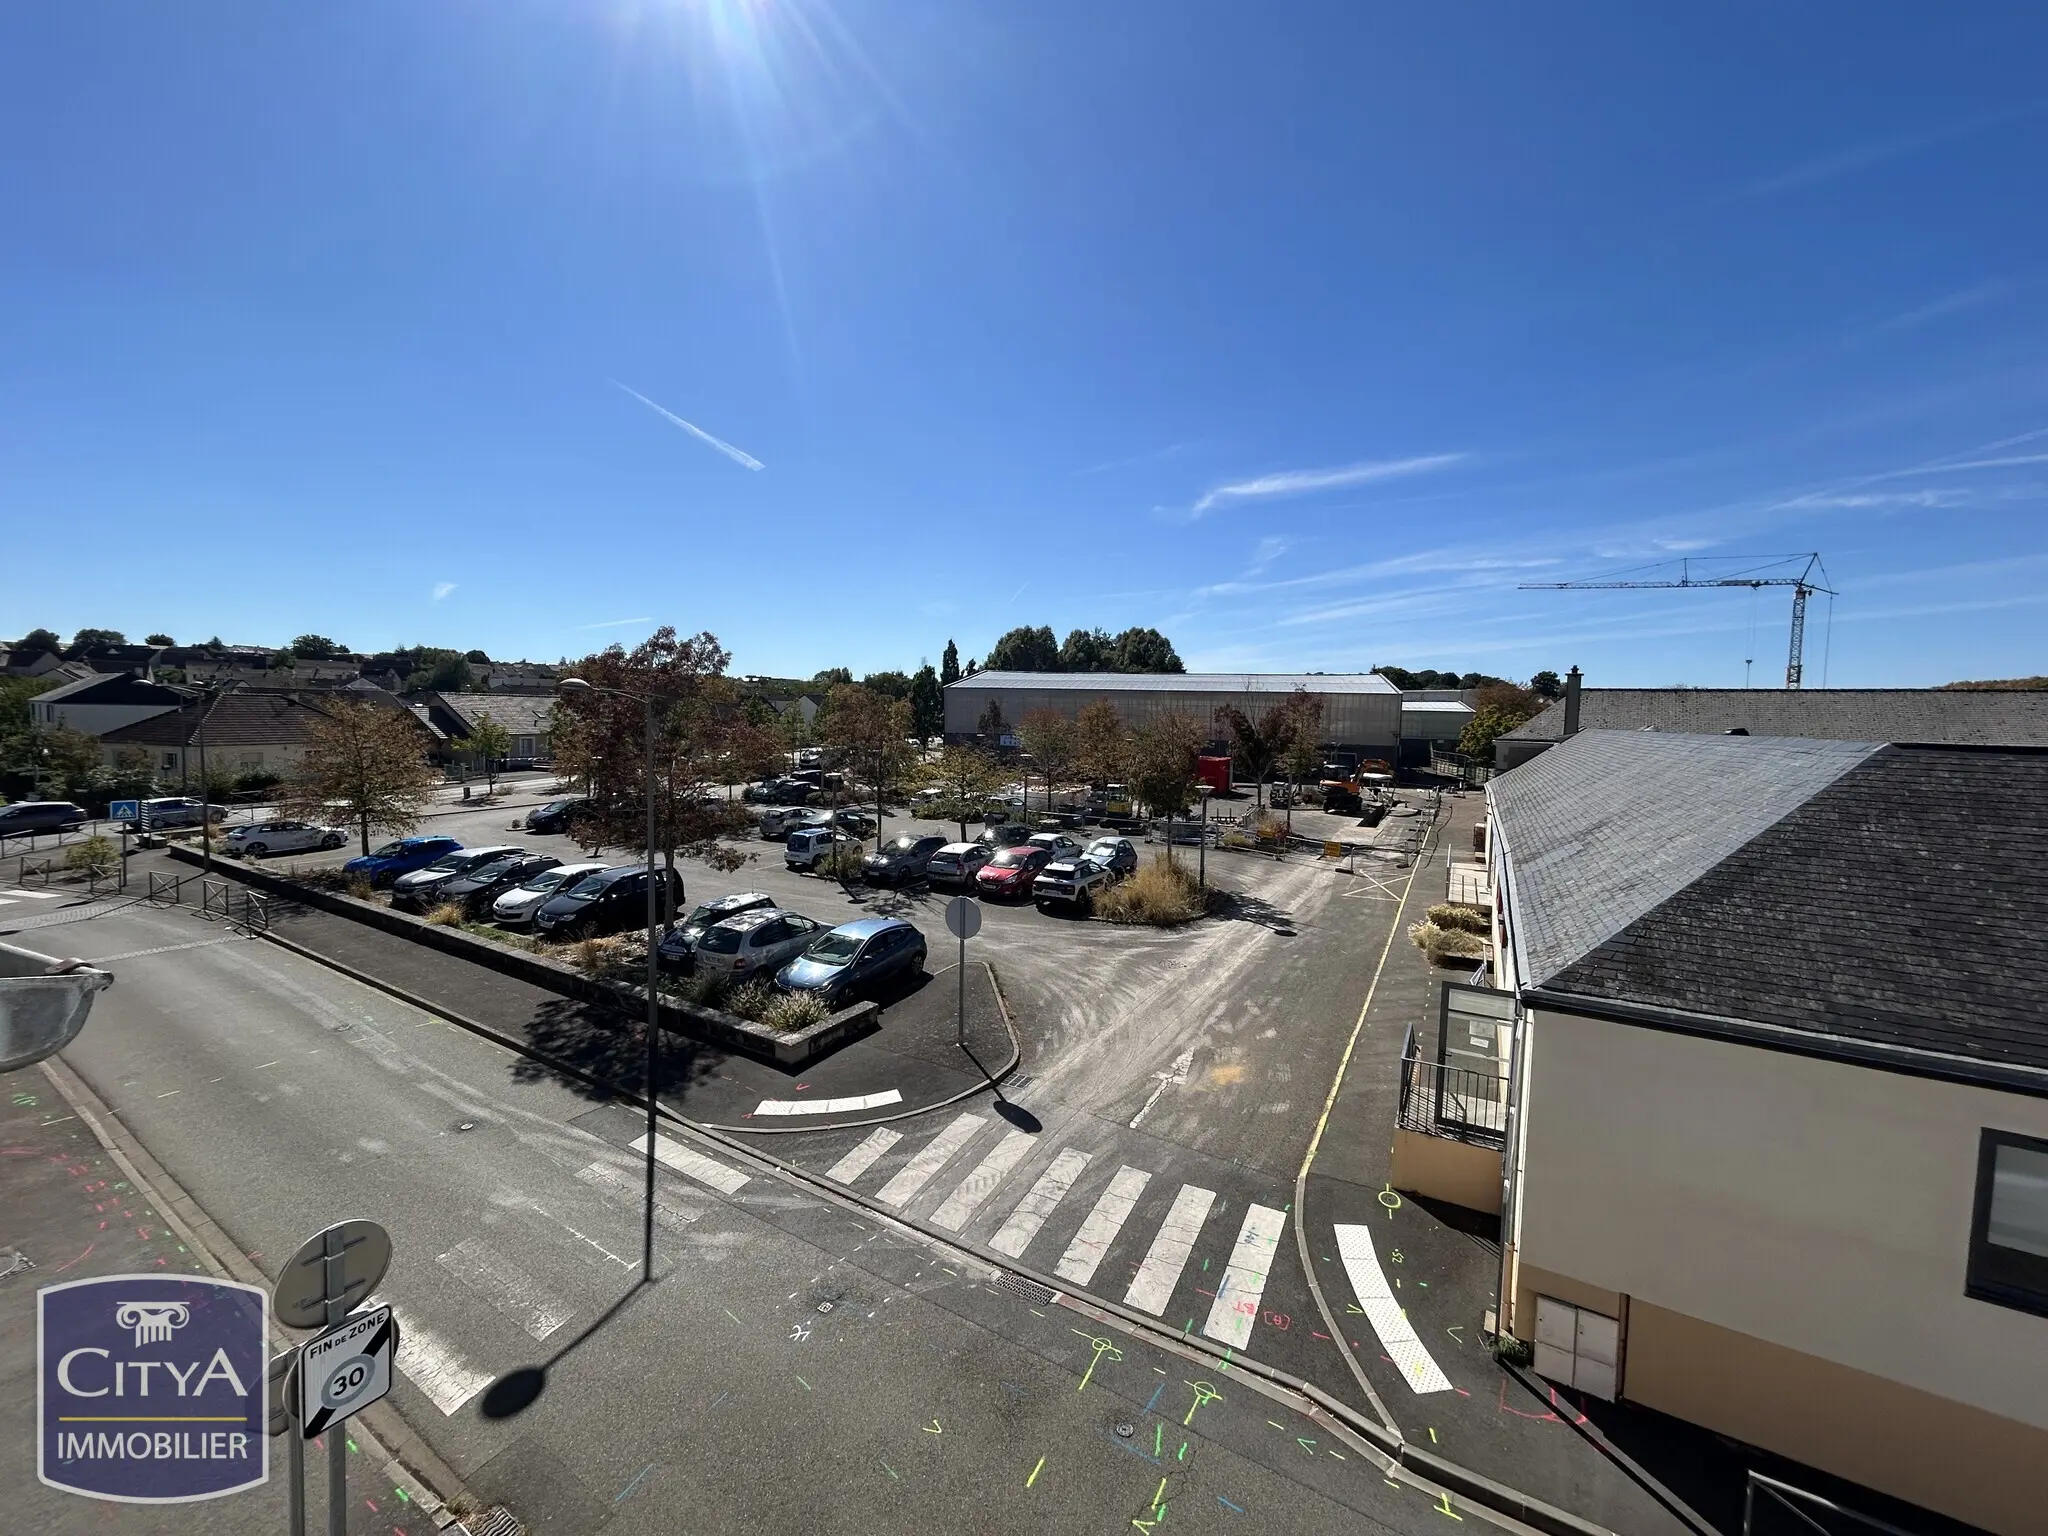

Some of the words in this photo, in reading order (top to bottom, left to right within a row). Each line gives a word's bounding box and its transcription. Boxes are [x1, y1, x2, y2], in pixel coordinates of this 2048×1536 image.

[309, 1339, 333, 1359] FIN
[334, 1335, 347, 1346] DE
[349, 1312, 385, 1339] ZONE
[333, 1366, 364, 1396] 30
